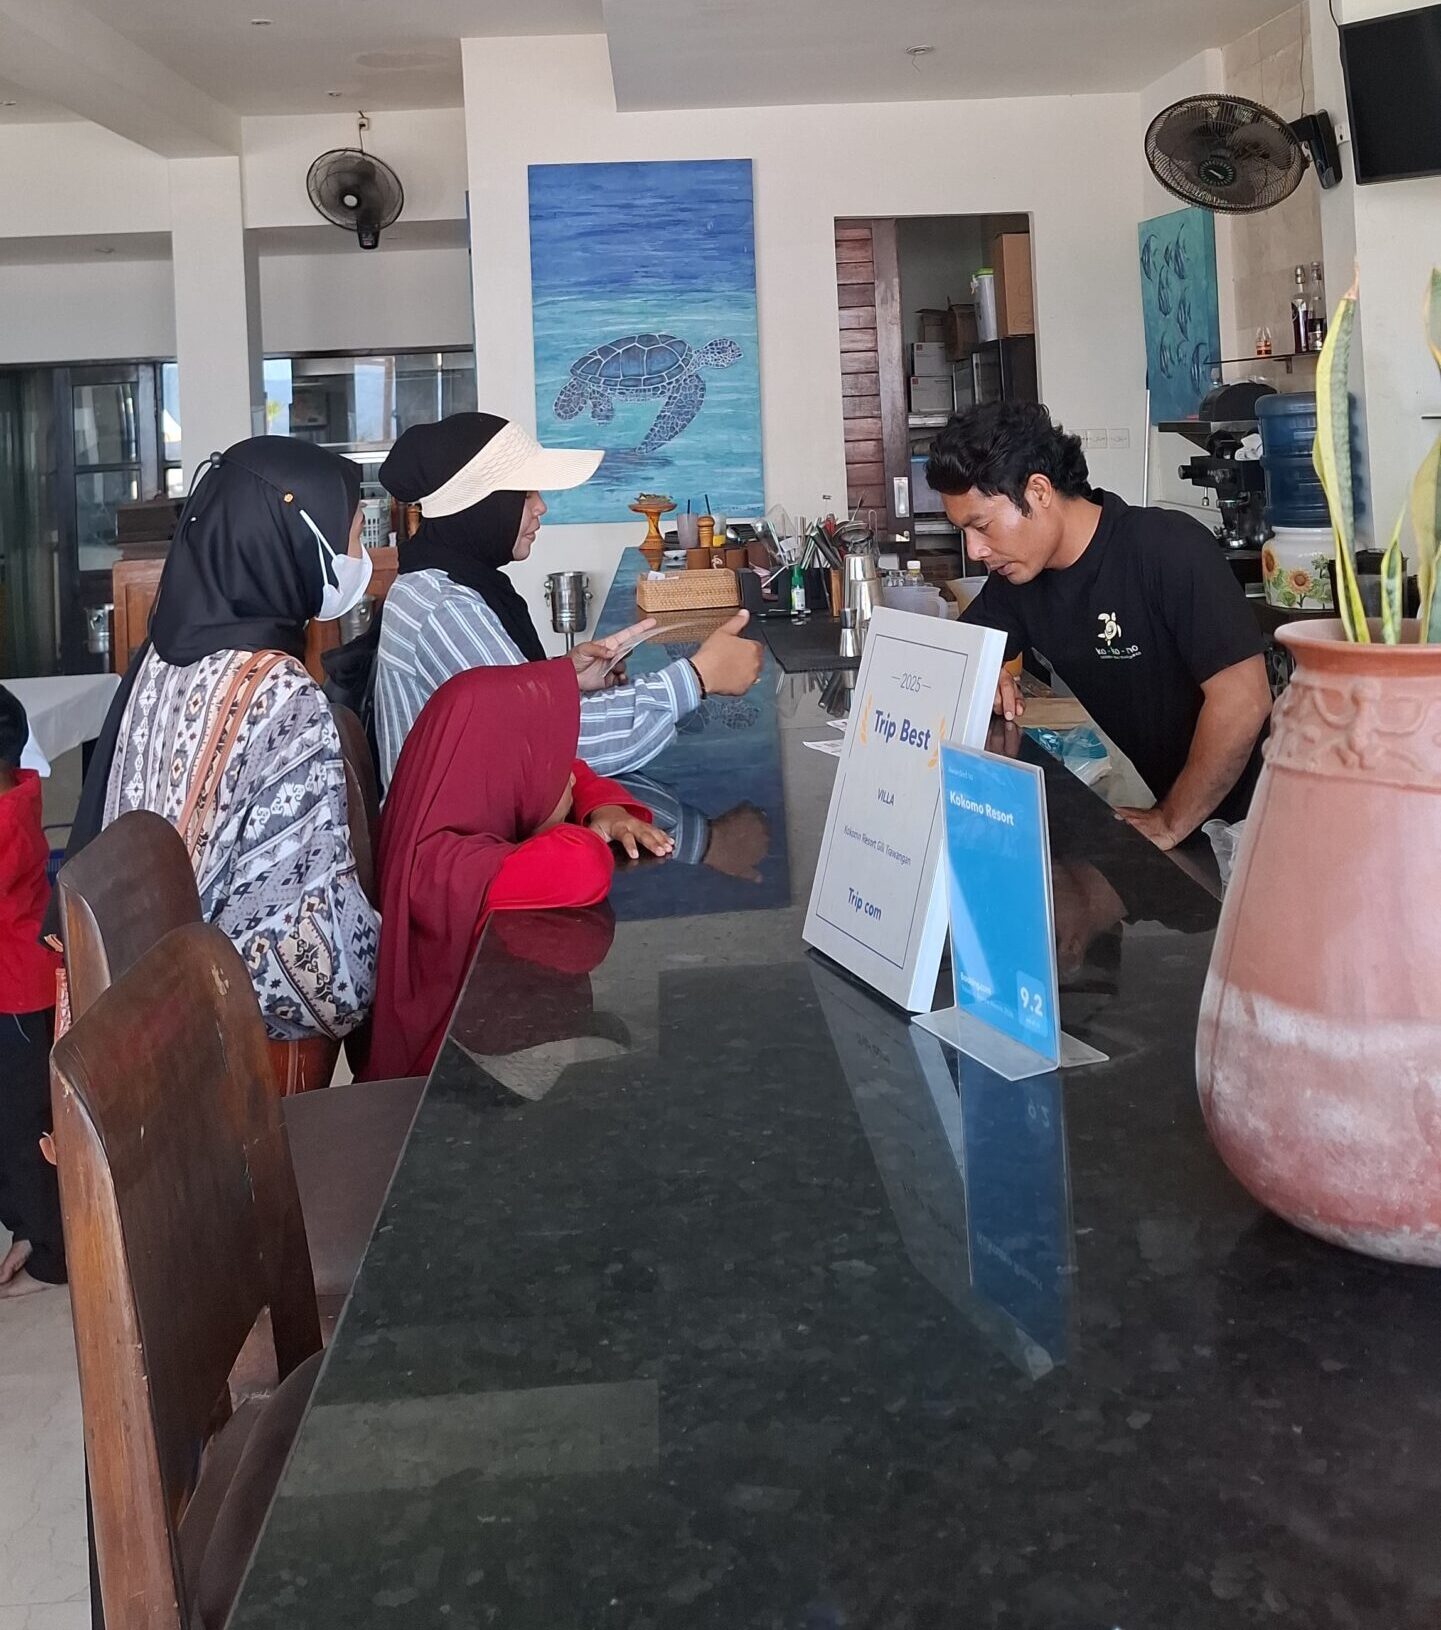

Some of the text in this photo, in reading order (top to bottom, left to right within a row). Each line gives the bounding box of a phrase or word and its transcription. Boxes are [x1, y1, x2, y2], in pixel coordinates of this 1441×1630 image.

[900, 672, 922, 693] 2025
[875, 709, 931, 751] Trip Best
[877, 788, 895, 806] VILLA
[950, 790, 1015, 826] Kokomo Resort
[862, 833, 877, 850] Resort
[1020, 986, 1043, 1017] 9.2
